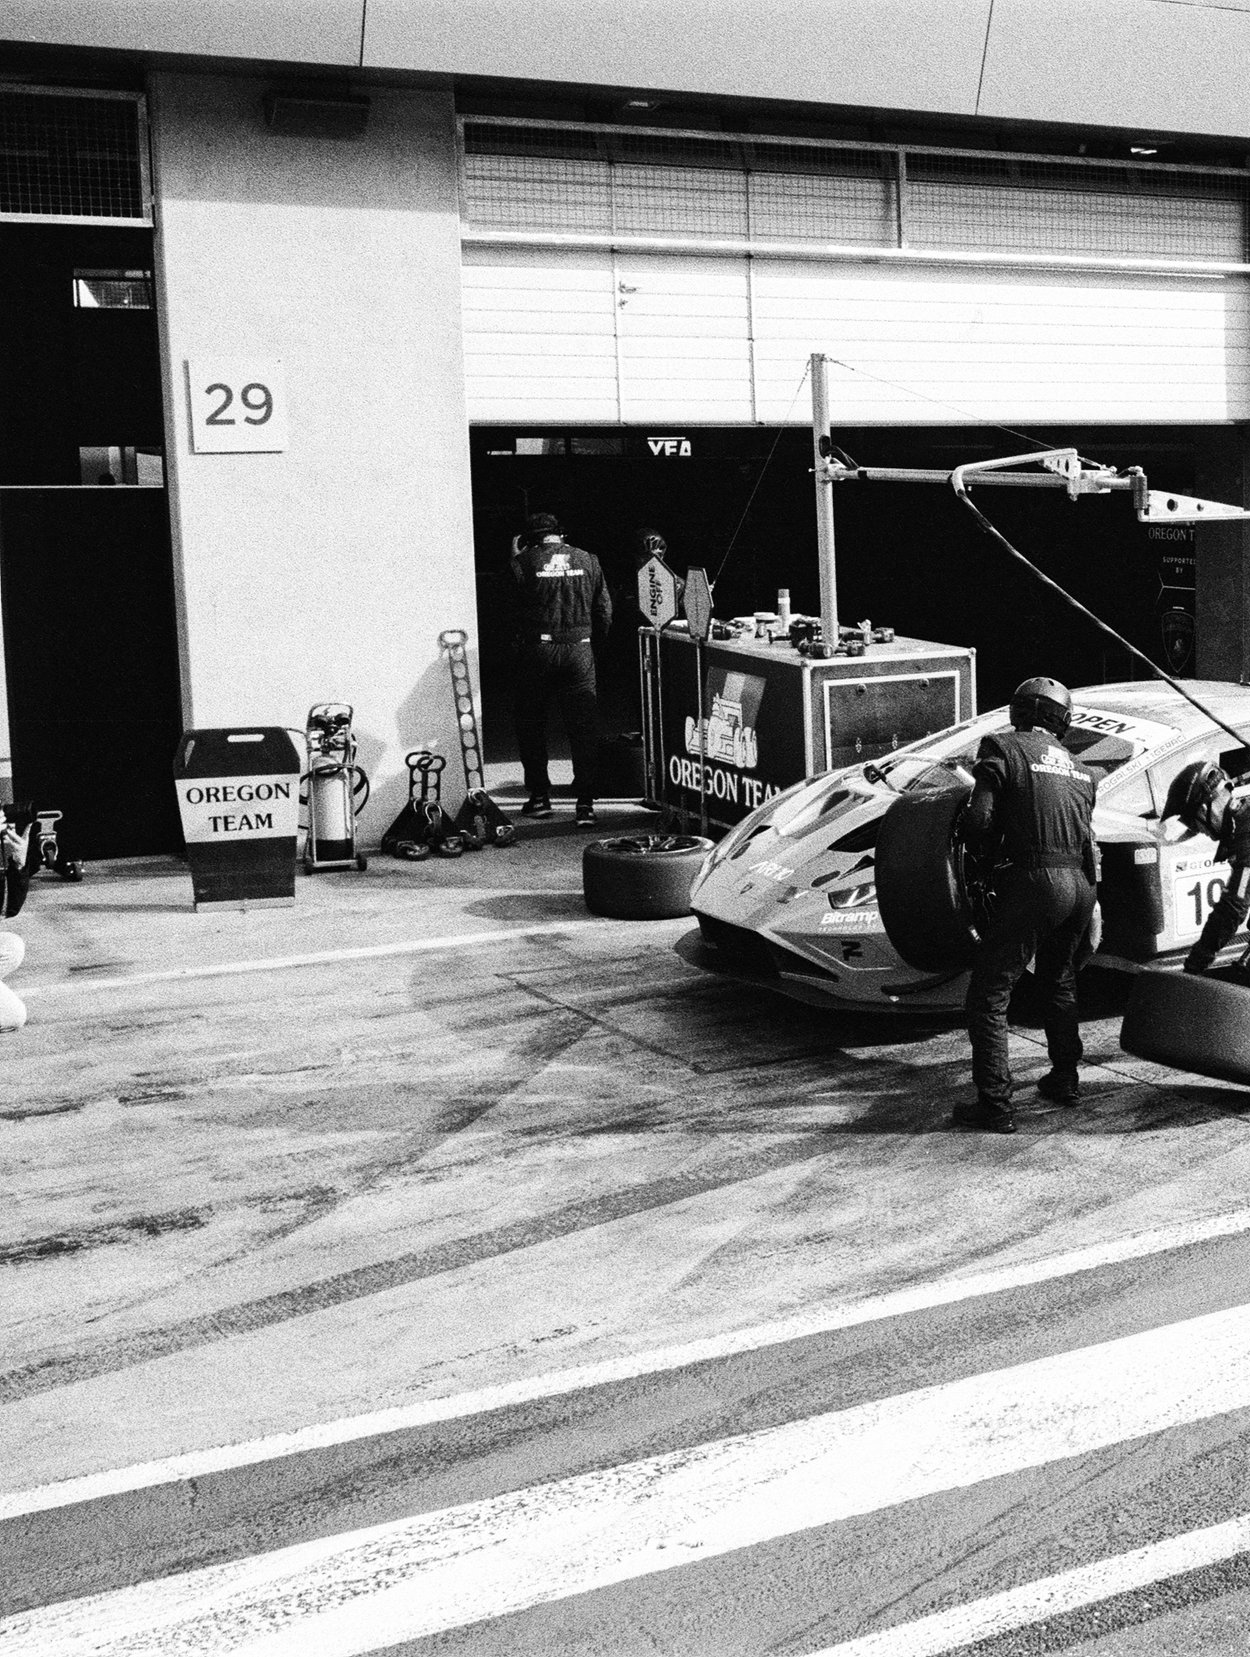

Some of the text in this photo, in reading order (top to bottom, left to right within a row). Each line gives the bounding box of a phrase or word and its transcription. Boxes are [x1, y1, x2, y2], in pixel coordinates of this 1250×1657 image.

[204, 382, 273, 425] 29
[1148, 527, 1187, 541] OREGON
[536, 570, 565, 578] OREGON
[648, 565, 658, 617] ENGINE
[656, 580, 664, 605] OFF
[1031, 763, 1071, 777] OREGON
[669, 755, 781, 809] OREGON TEA
[186, 783, 290, 804] OREGON
[208, 813, 273, 832] TEAM
